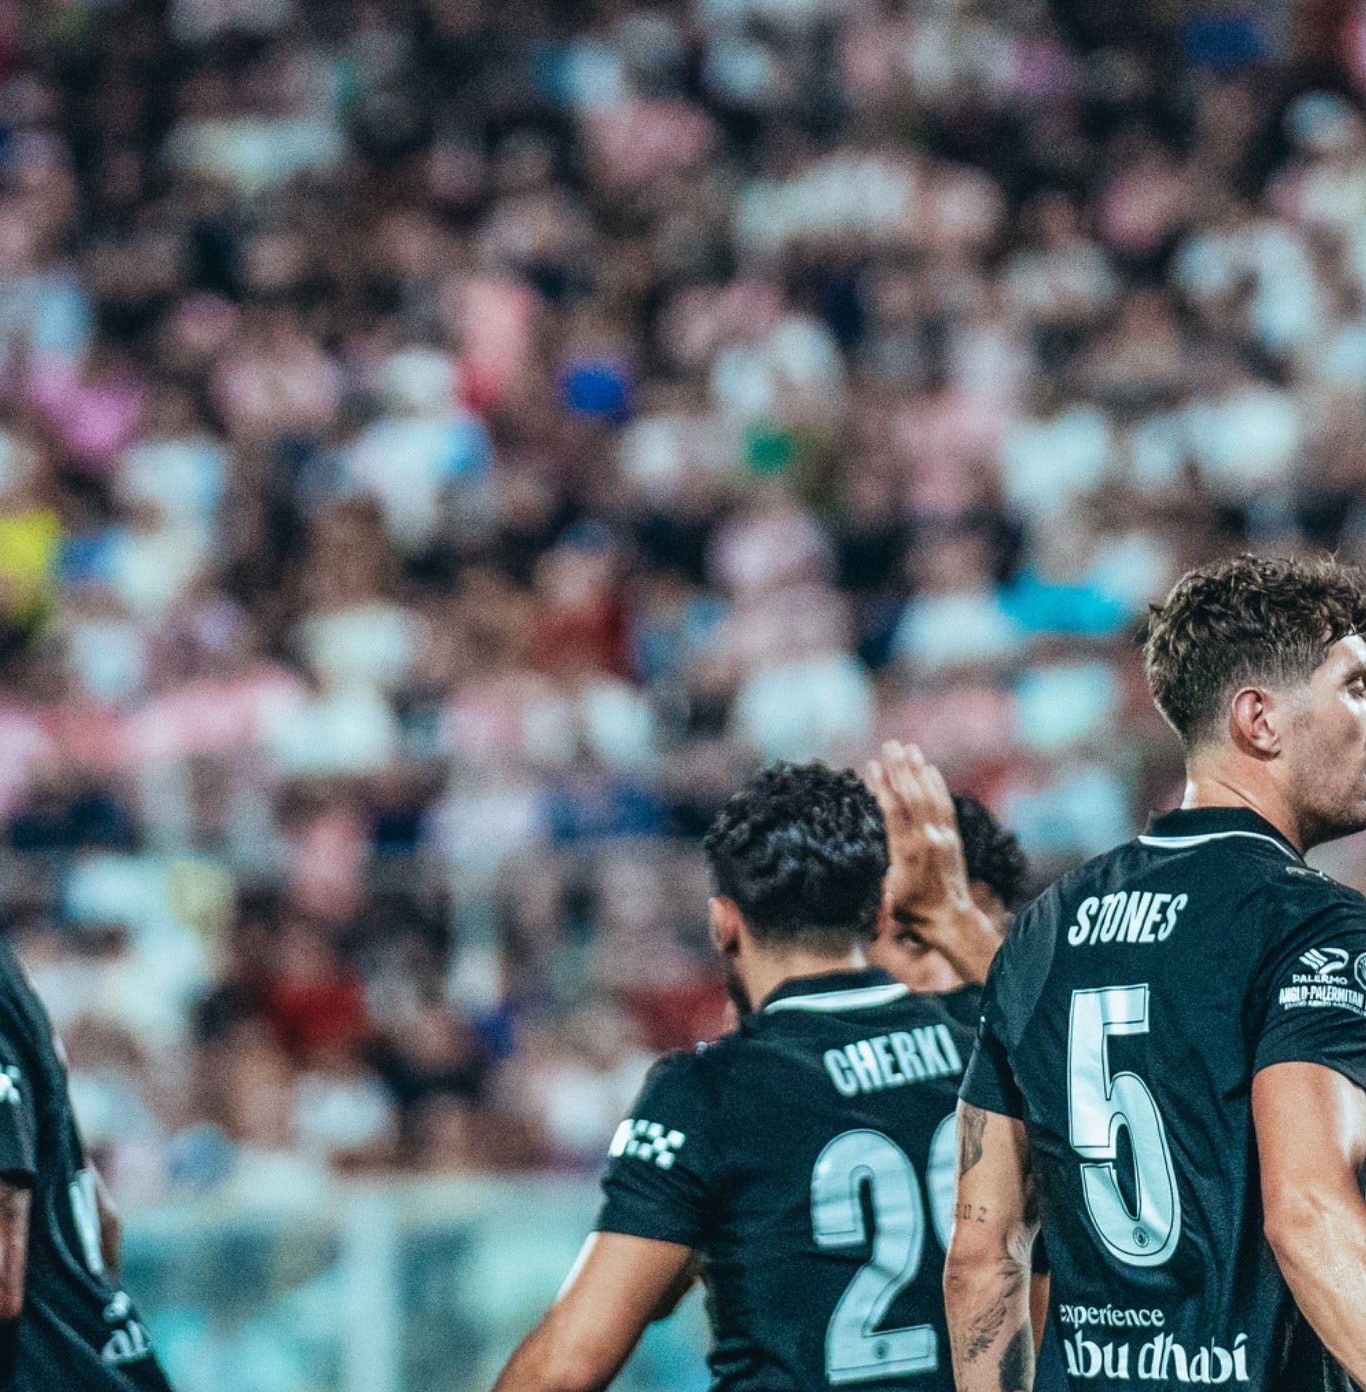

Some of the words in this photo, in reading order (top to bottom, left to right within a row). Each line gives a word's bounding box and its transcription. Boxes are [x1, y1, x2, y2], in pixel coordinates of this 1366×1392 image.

[1067, 890, 1189, 947] STONES
[1292, 973, 1348, 985] PALERMO
[822, 1023, 963, 1098] CHERKI
[1066, 982, 1181, 1267] 5
[1059, 1303, 1166, 1329] experience
